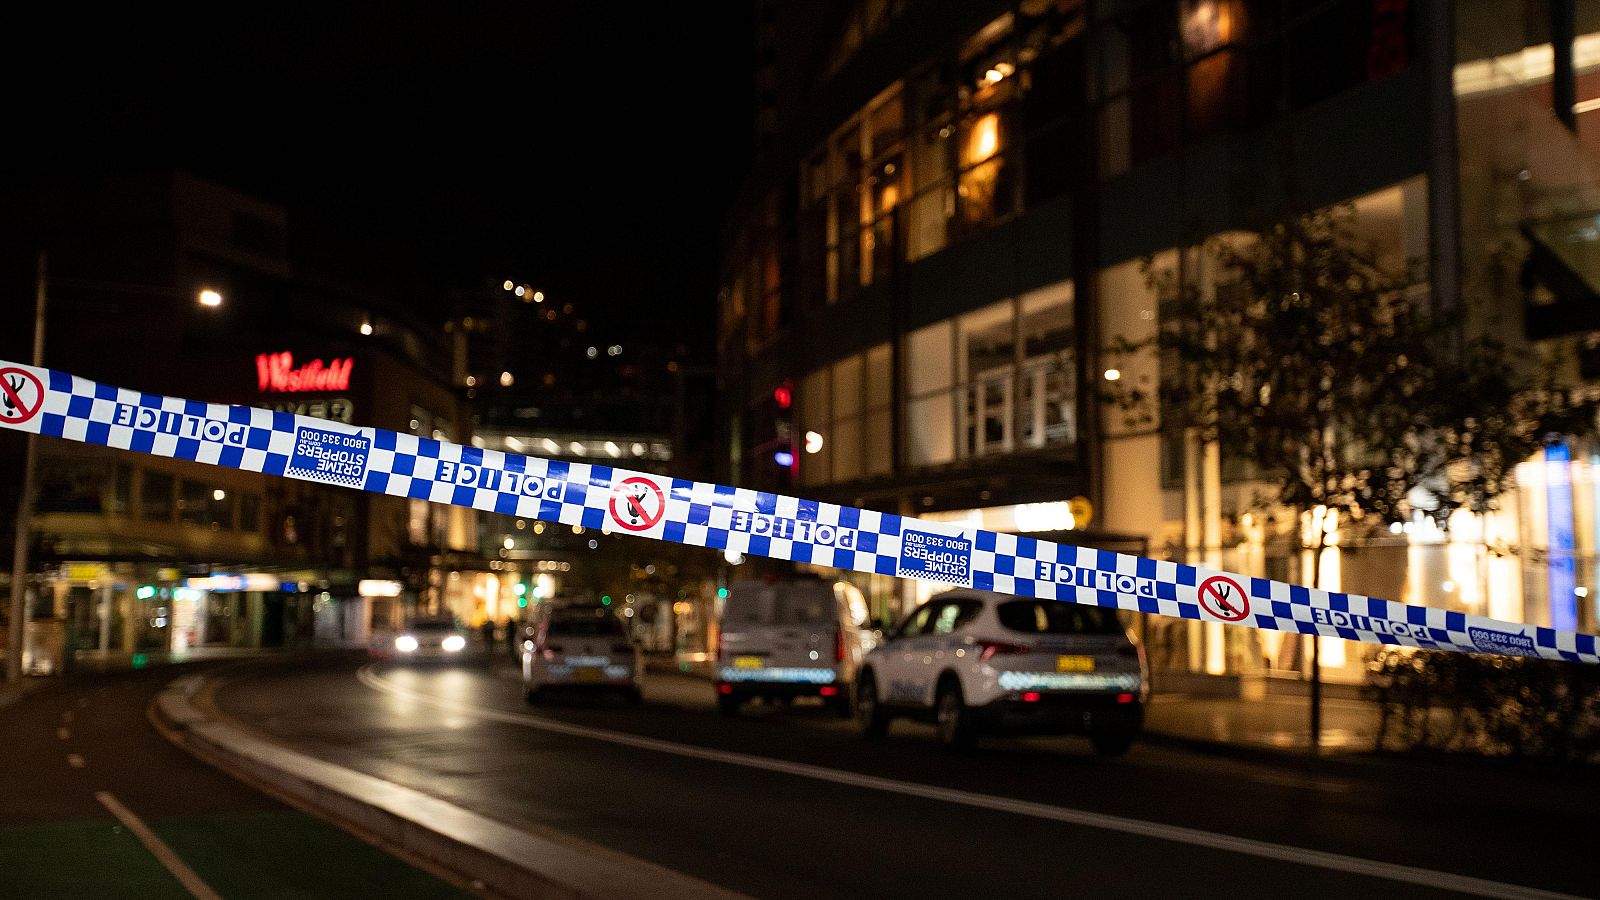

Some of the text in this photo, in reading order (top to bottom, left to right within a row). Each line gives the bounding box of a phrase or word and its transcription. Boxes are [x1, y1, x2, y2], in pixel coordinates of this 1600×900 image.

[256, 351, 353, 392] Westfield
[117, 404, 246, 445] POLICE
[301, 430, 367, 449] 1800 333 000
[297, 444, 365, 465] STOPPERS
[316, 459, 362, 476] CRIME
[440, 461, 563, 500] POLICE
[734, 510, 854, 548] POLICE
[906, 533, 968, 551] 1800 333 000
[904, 546, 968, 566] STOPPERS
[925, 560, 967, 576] CRIME
[1040, 562, 1153, 596] POLICE
[1315, 608, 1430, 640] POLICE
[1471, 630, 1531, 647] 1800 333 000
